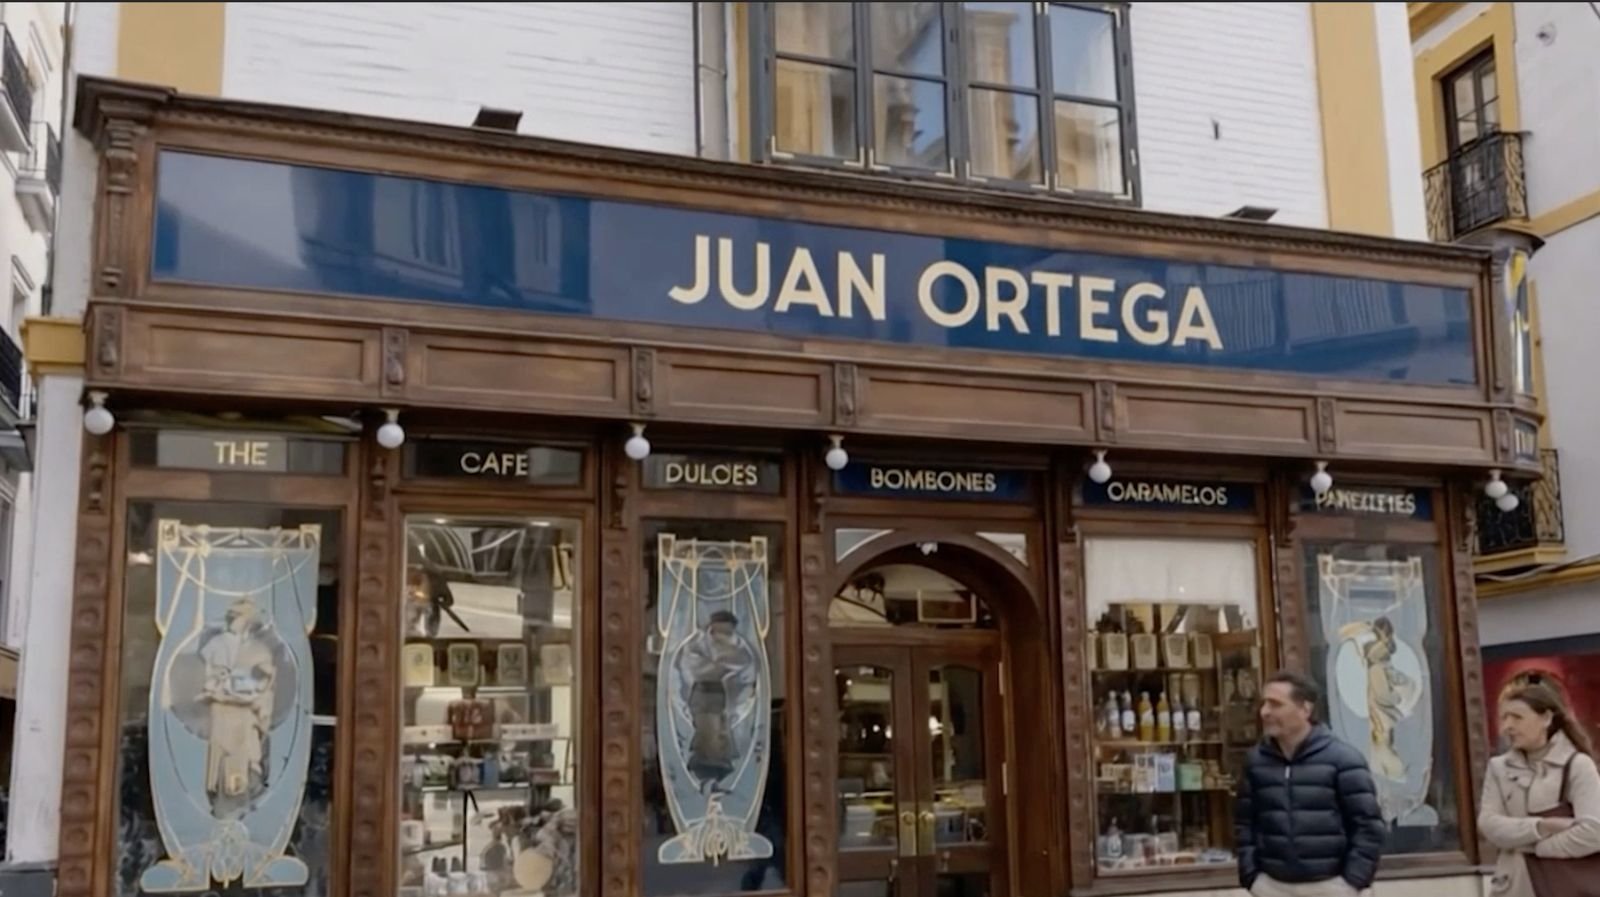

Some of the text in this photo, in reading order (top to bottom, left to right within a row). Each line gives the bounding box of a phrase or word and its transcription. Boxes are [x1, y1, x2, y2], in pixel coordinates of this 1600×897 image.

[668, 234, 1224, 349] JUAN ORTEGA
[214, 441, 269, 466] THE
[460, 451, 528, 476] CAFE
[870, 467, 997, 492] BOMBONES
